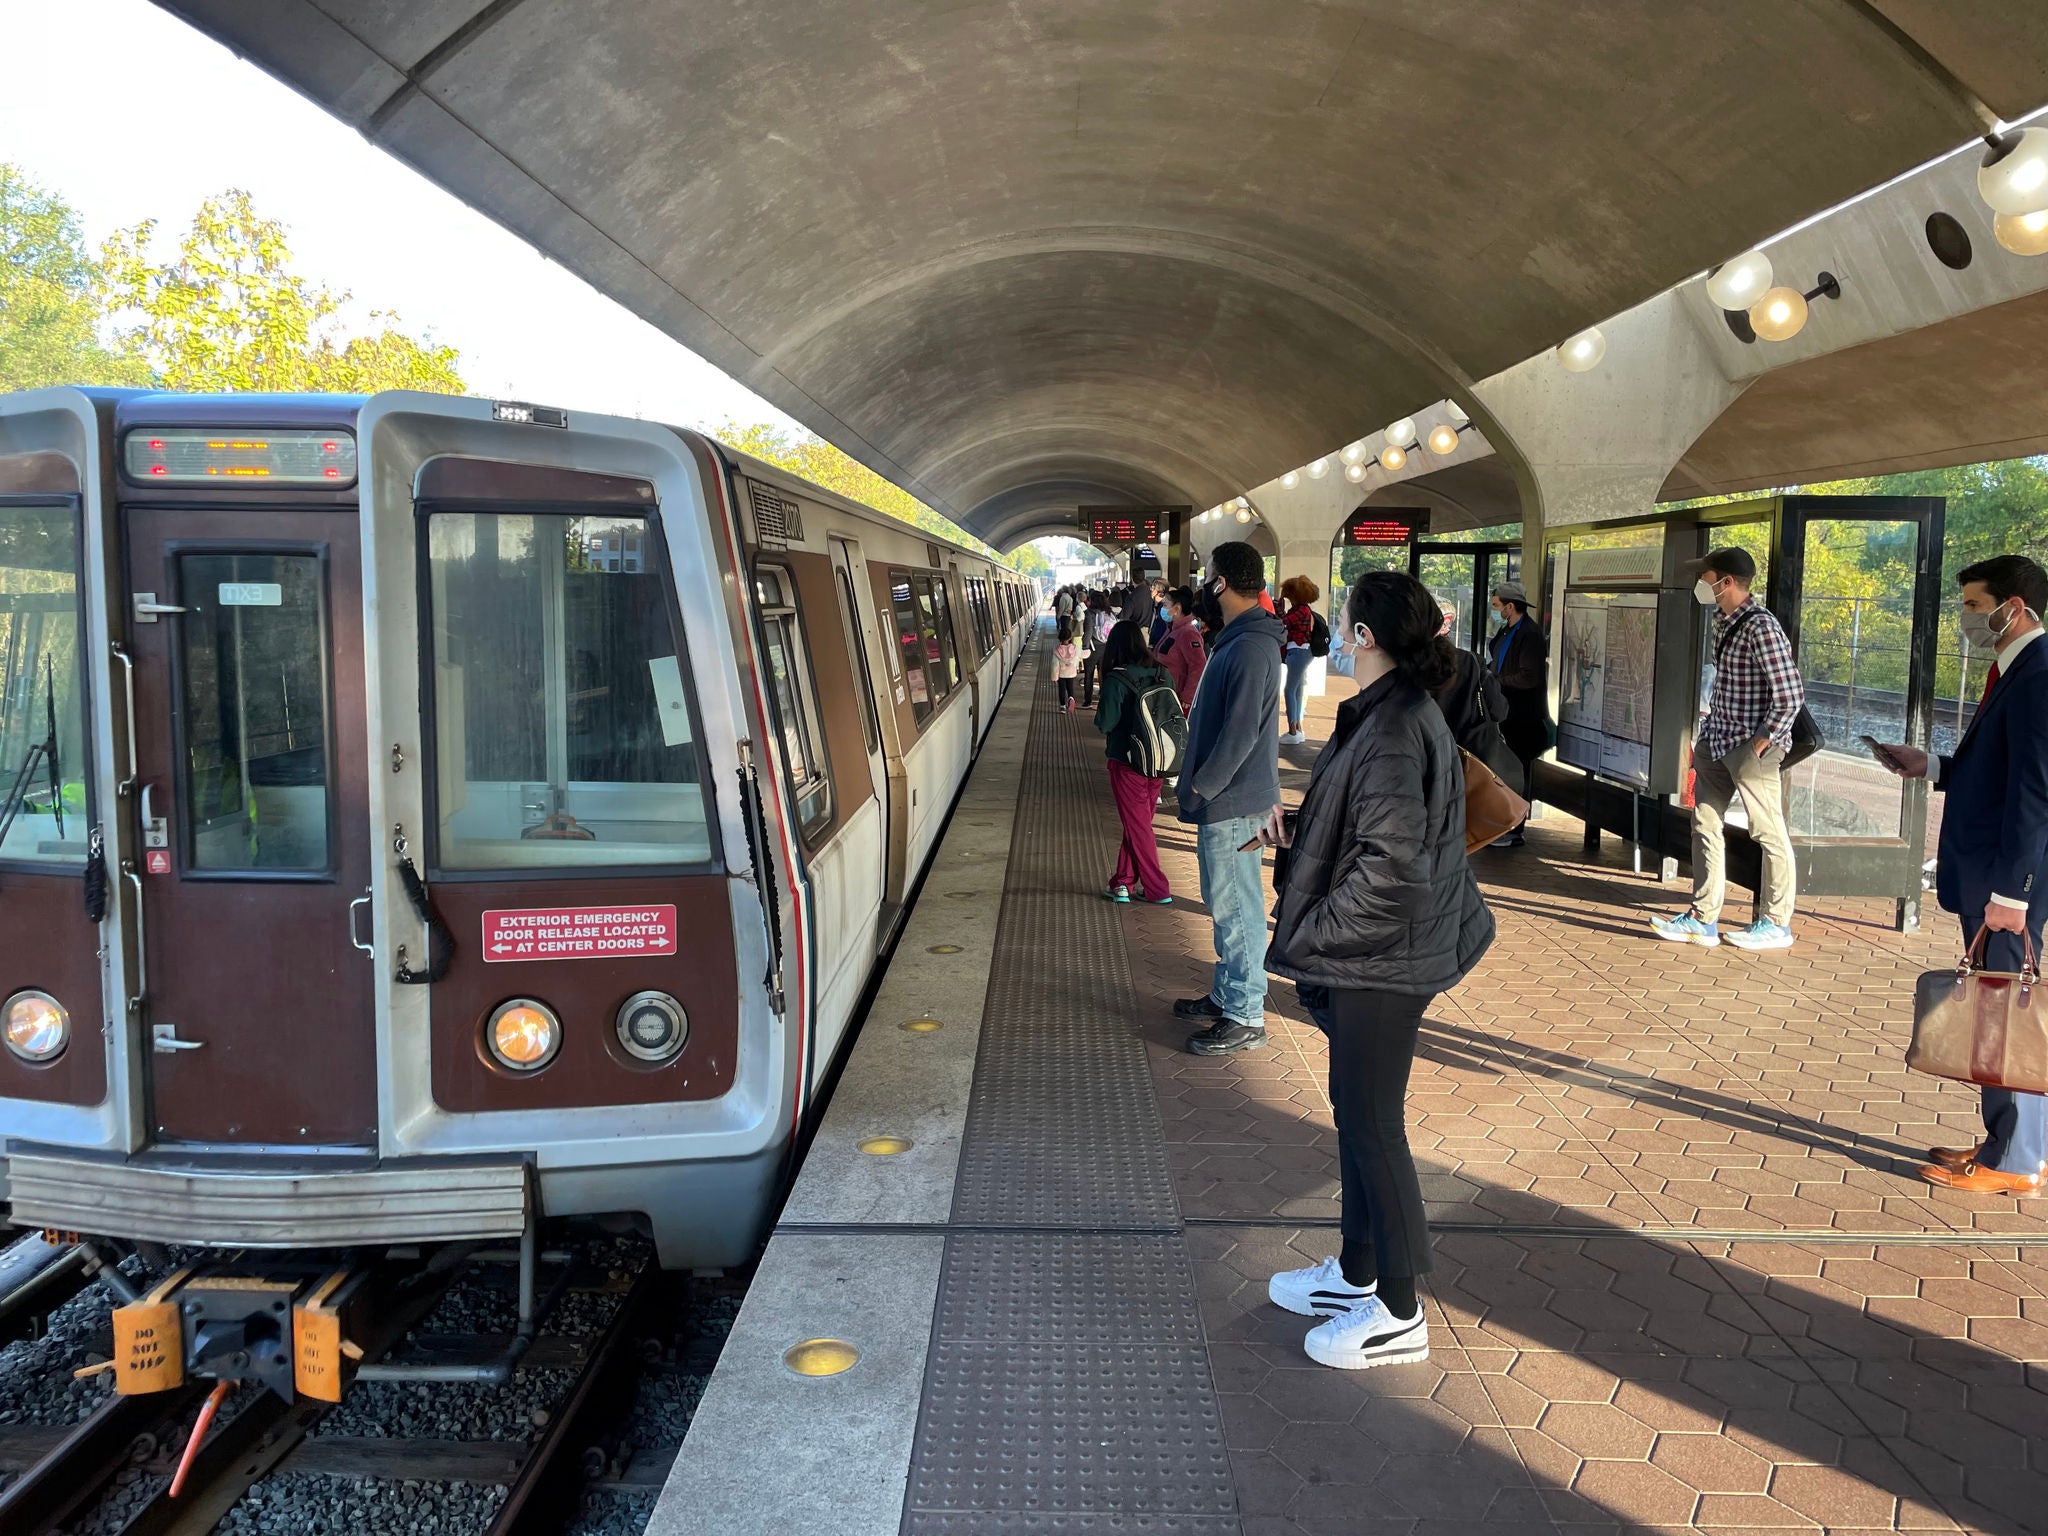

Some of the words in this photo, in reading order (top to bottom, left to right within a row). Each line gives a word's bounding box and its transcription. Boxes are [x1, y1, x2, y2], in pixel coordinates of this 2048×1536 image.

[500, 915, 570, 927] EXTERIOR
[574, 912, 660, 925] EMERGENCY
[494, 929, 534, 941] DOOR
[538, 927, 600, 939] RELEASE
[604, 925, 666, 937] LOCATED
[516, 942, 534, 953] AT
[538, 940, 594, 952] CENTER
[598, 938, 645, 950] DOORS
[135, 1329, 154, 1339] DO
